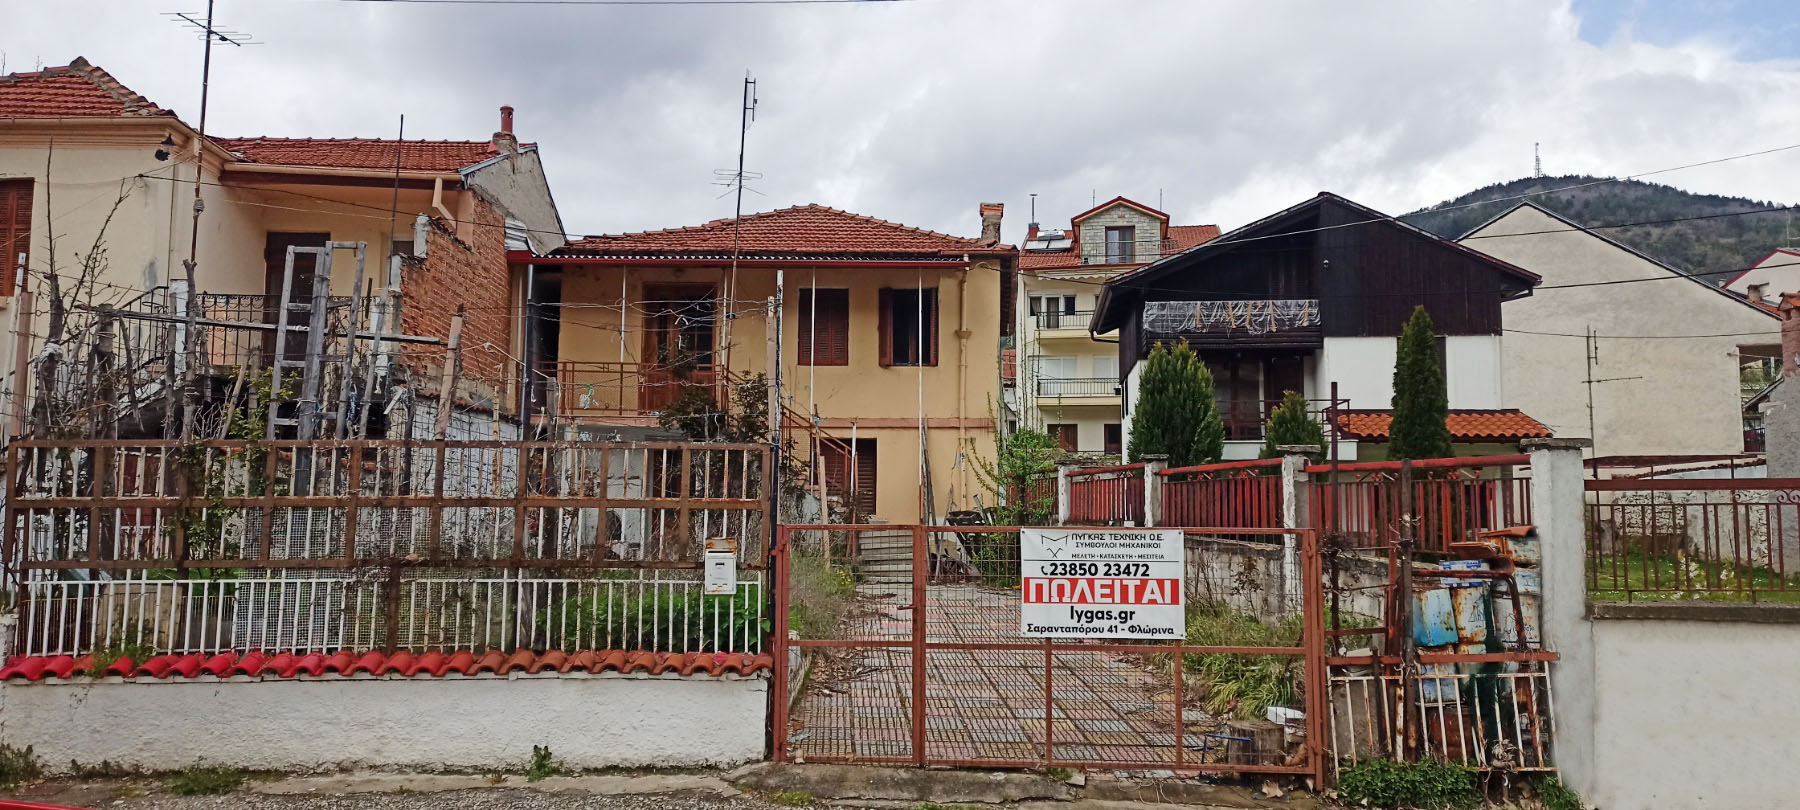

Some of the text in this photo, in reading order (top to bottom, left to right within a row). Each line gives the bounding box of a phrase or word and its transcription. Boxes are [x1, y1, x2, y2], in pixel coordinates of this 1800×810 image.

[1108, 533, 1146, 541] ΤΕΧΝΙΚΗ
[1049, 563, 1150, 577] 23850 23472
[1029, 578, 1171, 604] ΠΩΛΕΙΤΑΙ
[1070, 606, 1136, 623] lygas.gr
[1027, 623, 1104, 636] Σαρανταπόρου
[1107, 625, 1118, 634] 41
[1128, 624, 1174, 635] Φλώρινα
